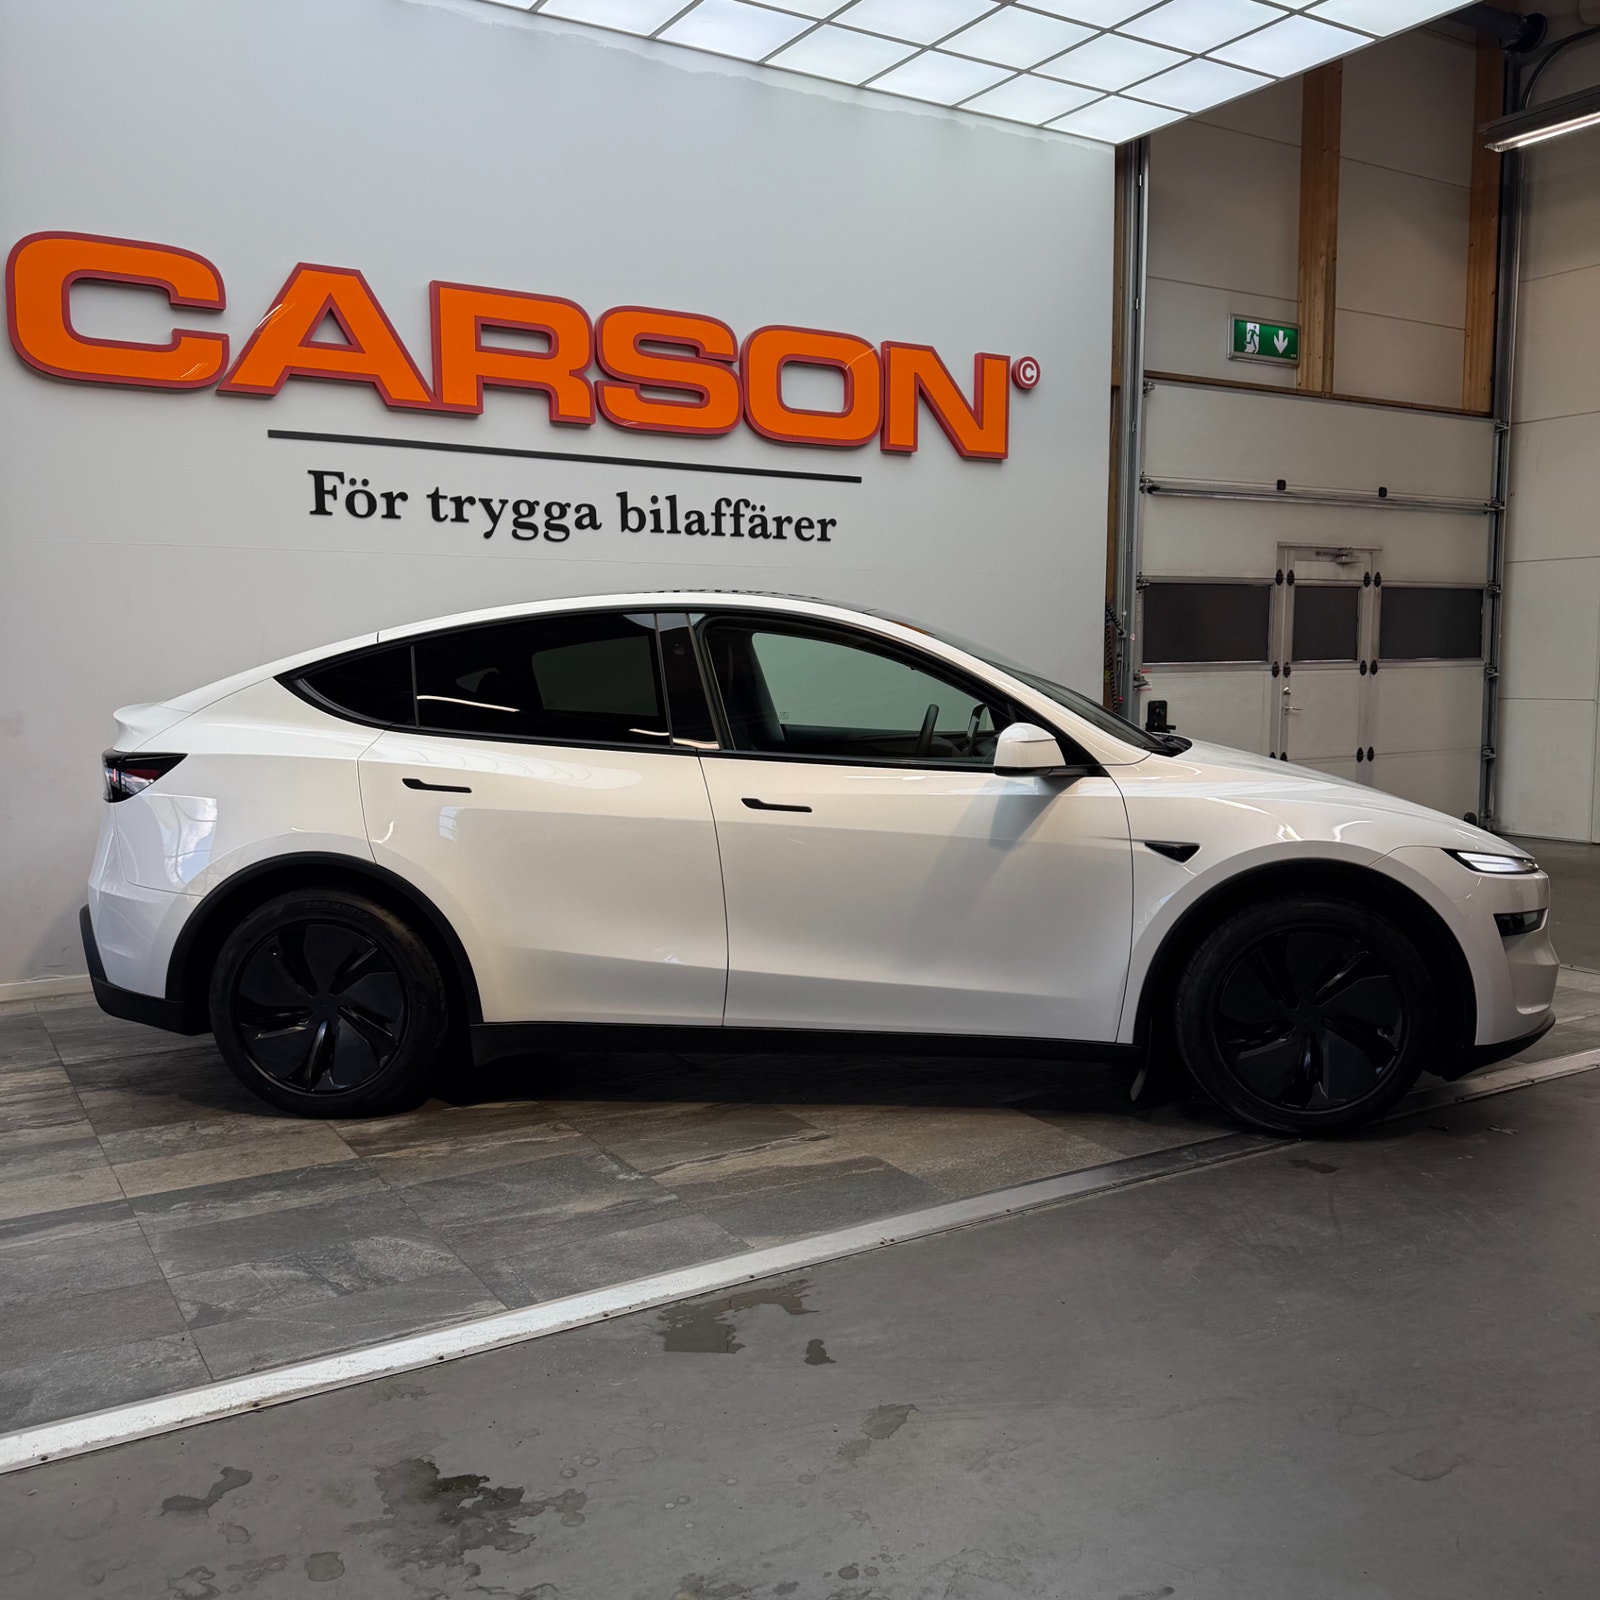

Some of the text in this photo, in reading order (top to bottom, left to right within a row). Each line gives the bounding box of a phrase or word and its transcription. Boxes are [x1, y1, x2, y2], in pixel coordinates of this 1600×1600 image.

[6, 231, 1011, 460] CARSON
[307, 470, 837, 542] För trygga bilaffärer
